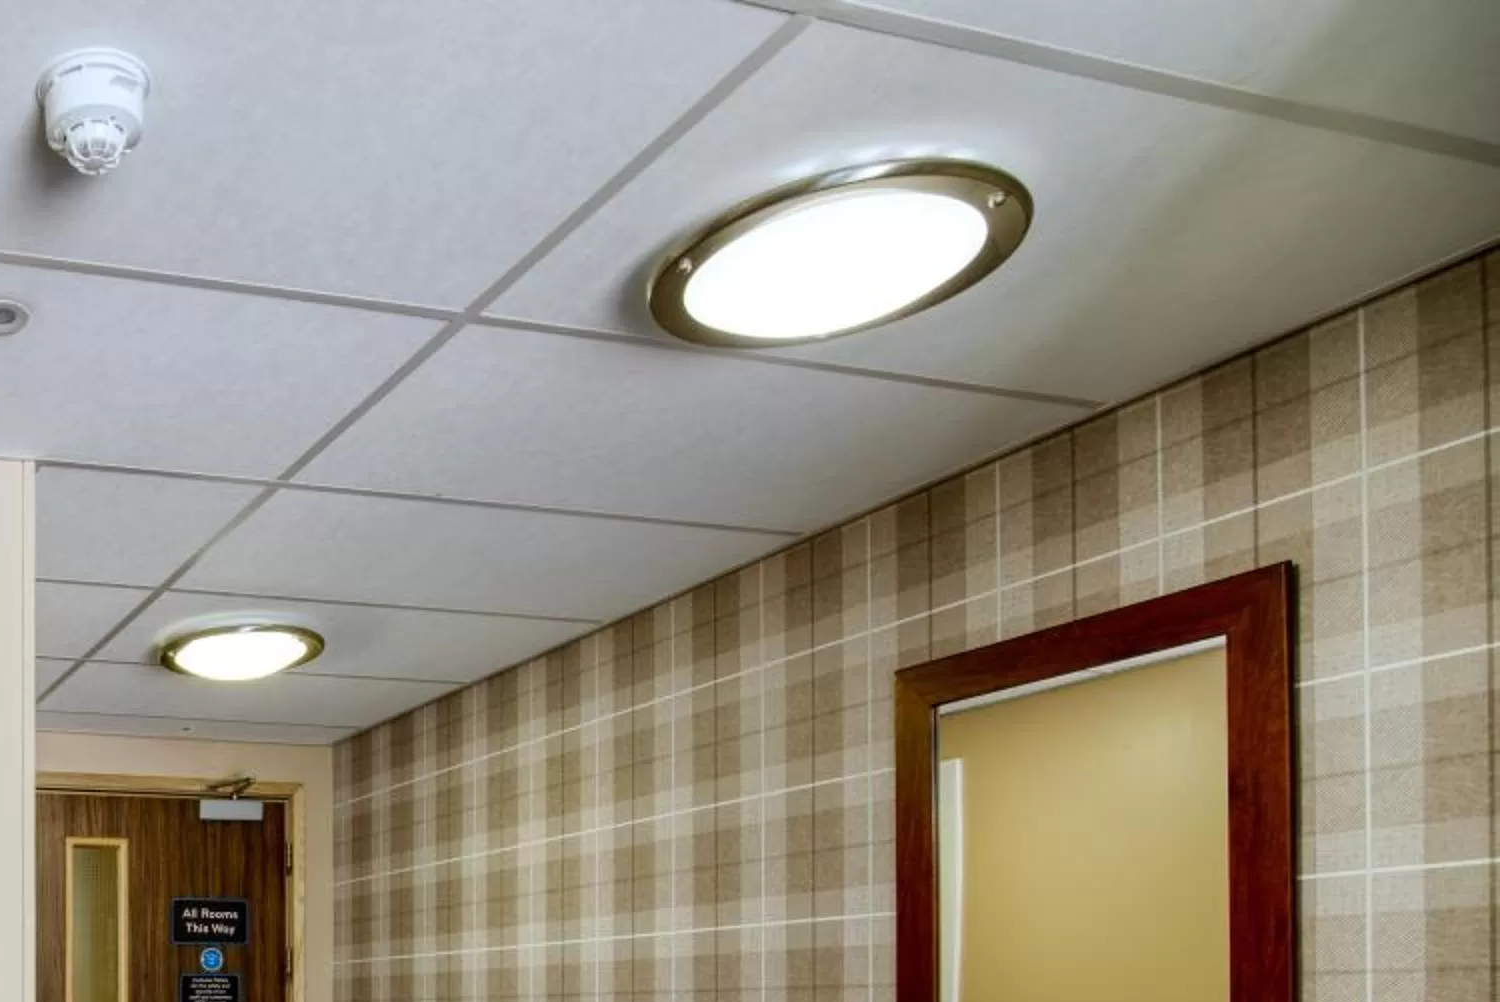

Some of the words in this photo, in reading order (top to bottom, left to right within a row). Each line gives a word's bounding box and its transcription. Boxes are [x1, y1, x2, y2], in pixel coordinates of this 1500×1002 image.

[182, 907, 198, 919] All
[201, 907, 239, 919] Rooms
[185, 922, 209, 934] This
[211, 923, 236, 937] Way
